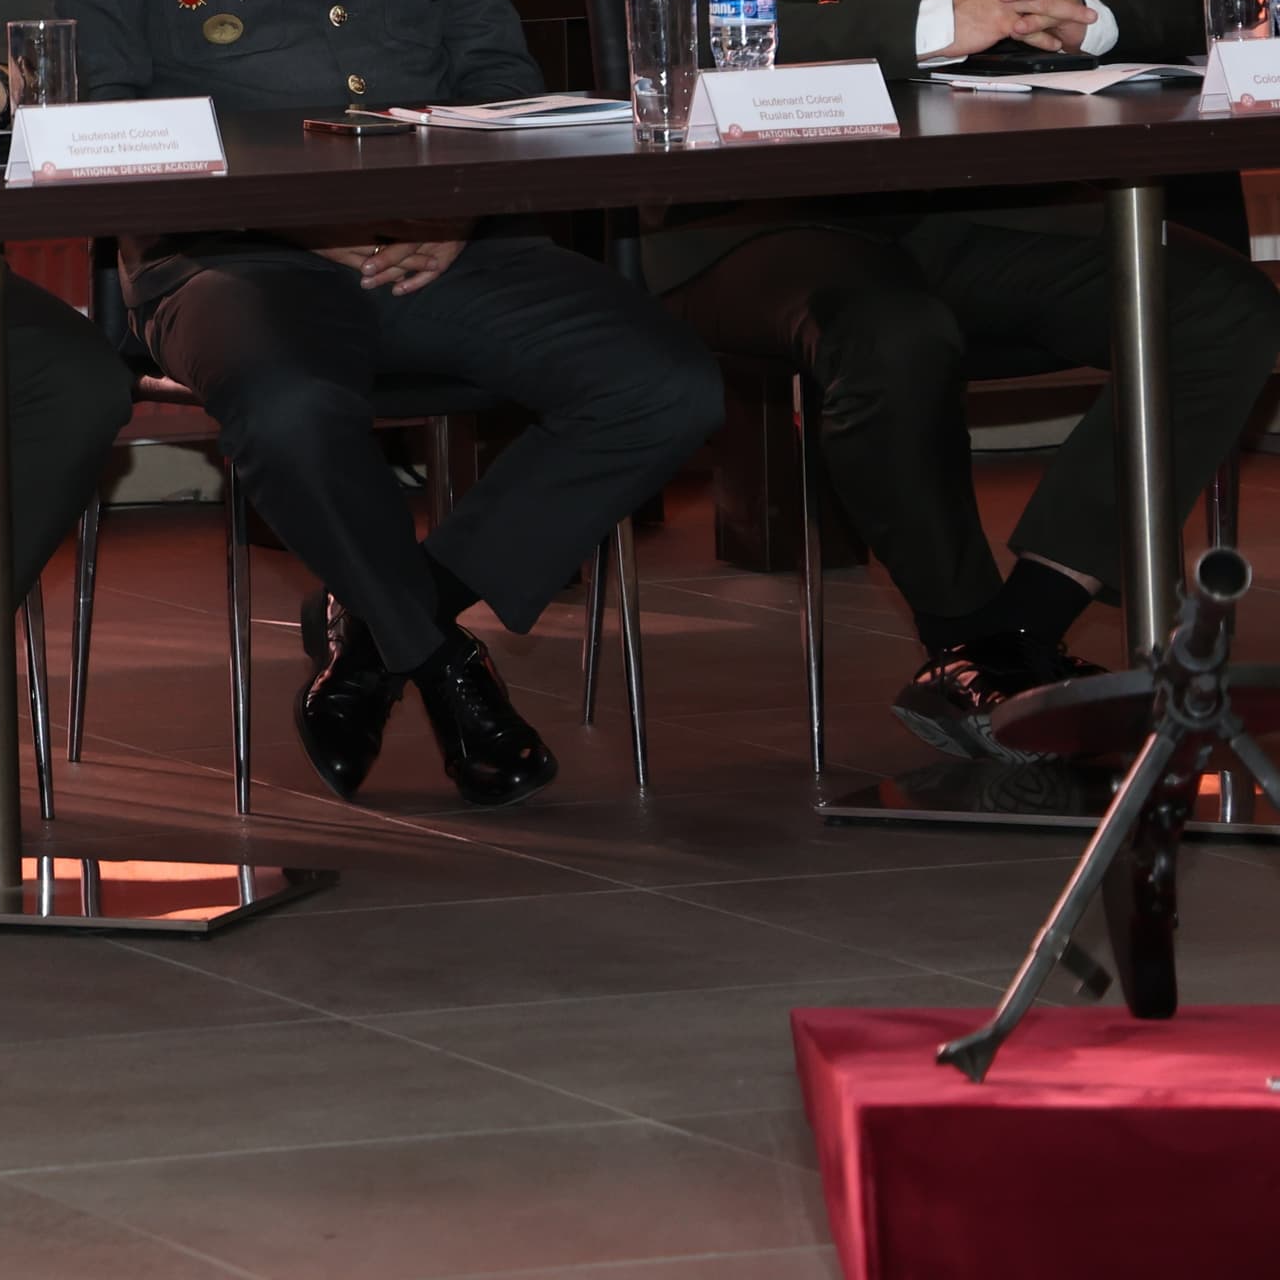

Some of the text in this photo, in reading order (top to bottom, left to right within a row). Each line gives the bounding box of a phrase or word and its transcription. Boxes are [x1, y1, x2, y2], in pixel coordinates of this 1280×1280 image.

[1253, 73, 1280, 86] Colo
[752, 93, 844, 108] Lieutenant Colonel
[759, 110, 794, 122] Ruslan
[72, 127, 169, 143] Lieutenant Colonel
[758, 125, 884, 140] NATIONAL DEFENCE ACADEMY
[72, 161, 209, 178] NATIONAL DEFENCE ACADEMY
